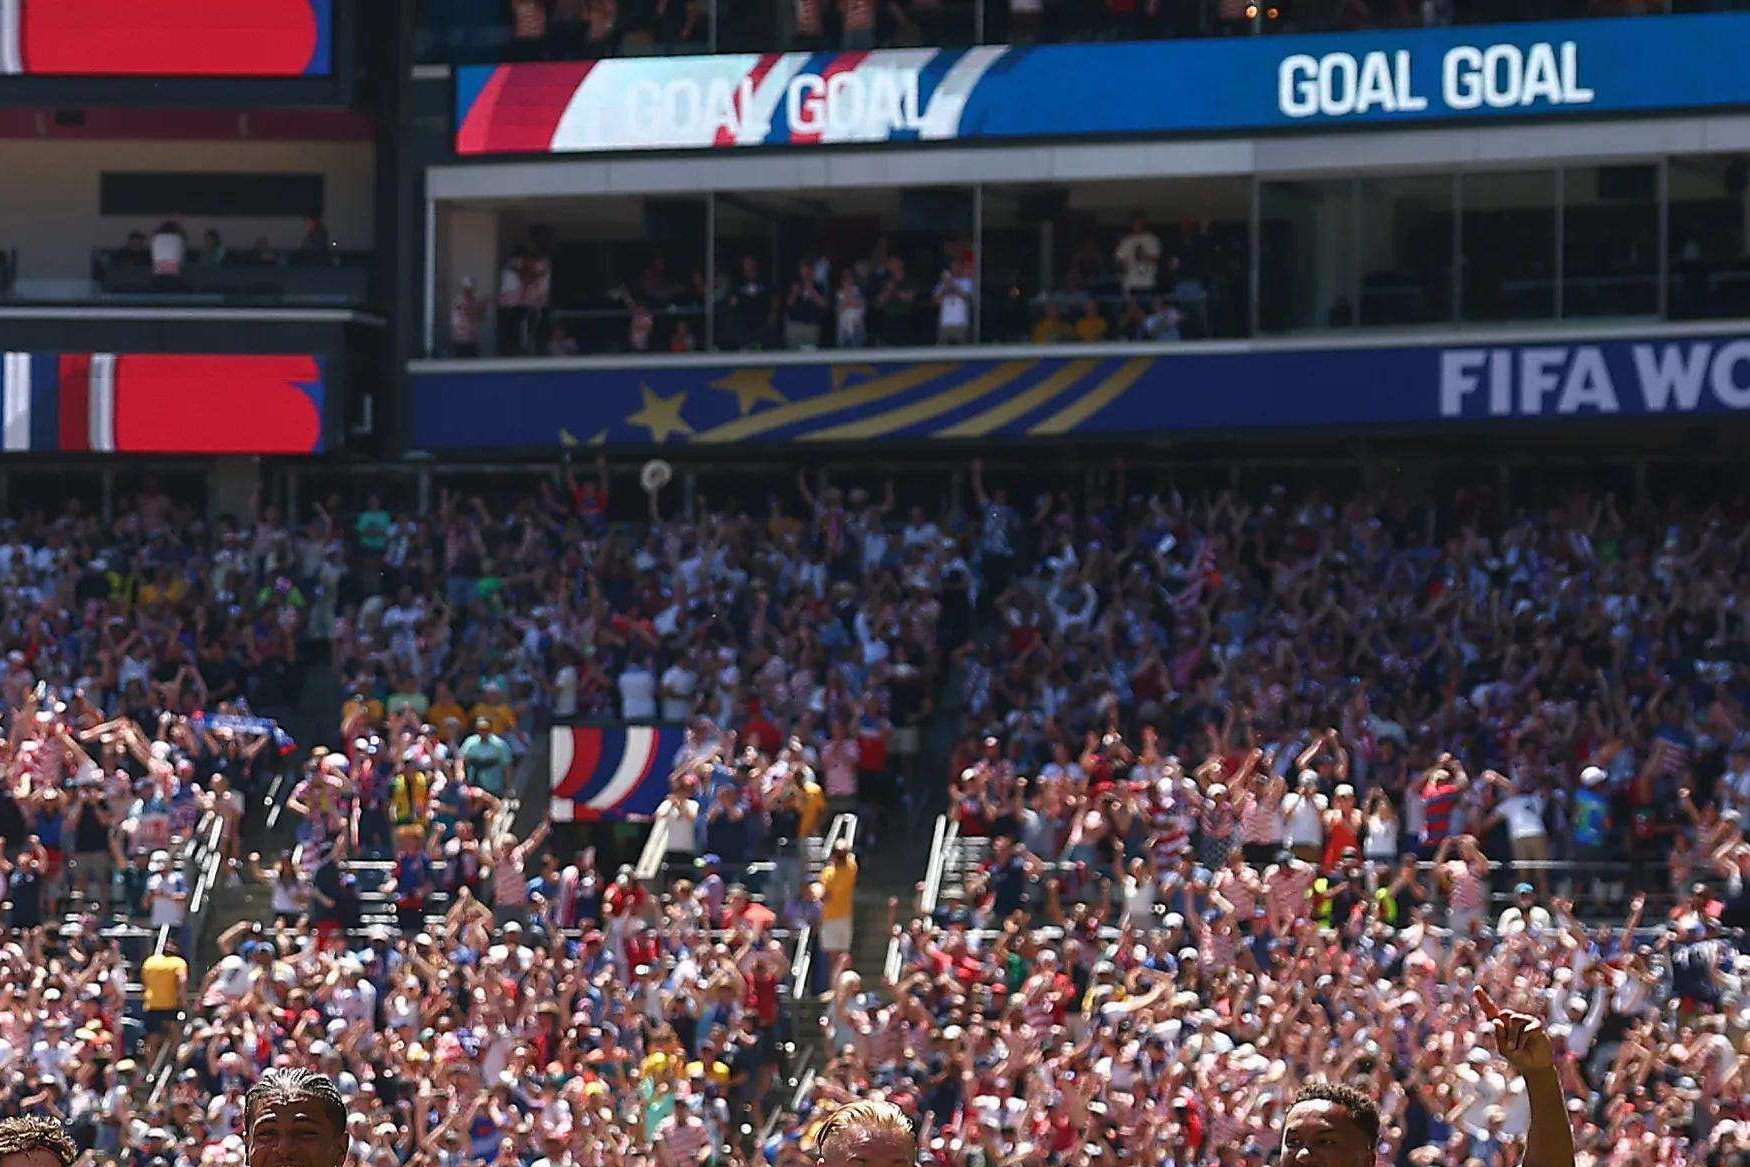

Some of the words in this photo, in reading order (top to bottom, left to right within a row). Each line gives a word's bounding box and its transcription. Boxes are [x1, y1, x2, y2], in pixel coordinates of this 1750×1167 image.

[629, 73, 771, 141] GOAL
[786, 64, 929, 134] GOAL
[1278, 50, 1428, 118] GOAL
[1442, 40, 1595, 110] GOAL
[1440, 345, 1619, 417] FIFA
[1632, 338, 1750, 411] WO
